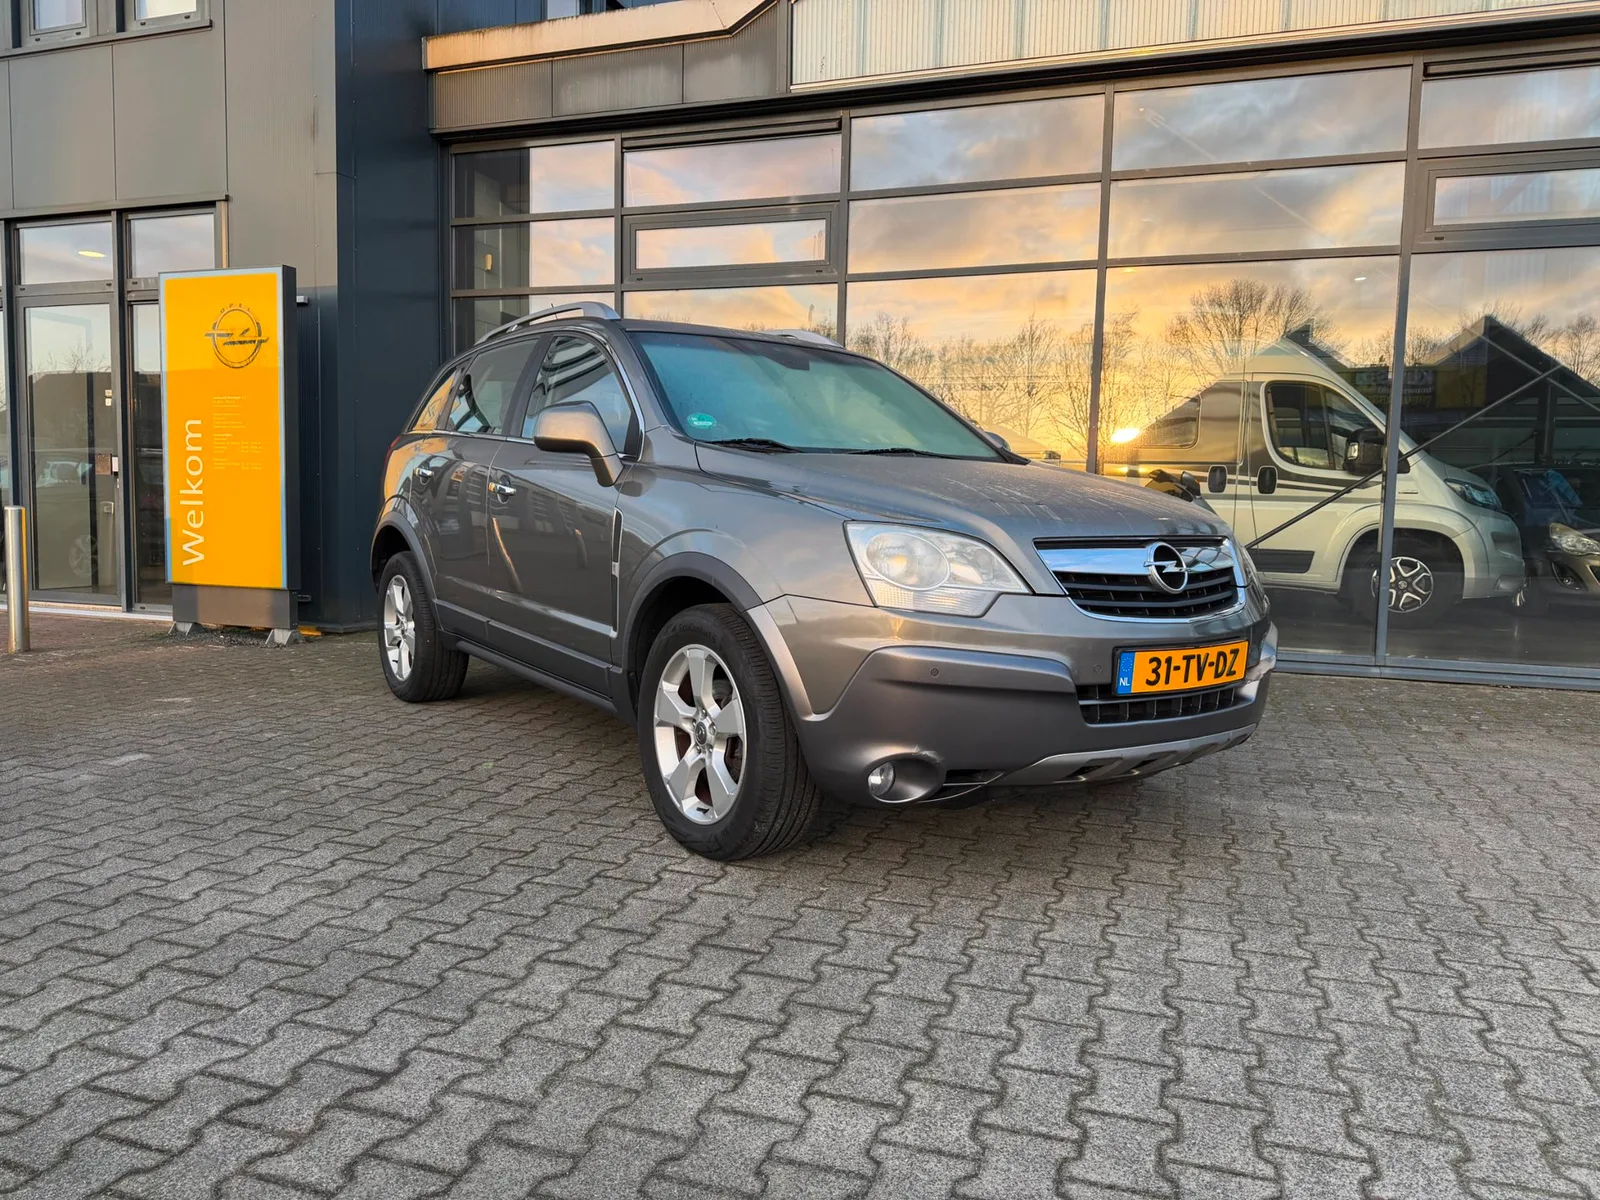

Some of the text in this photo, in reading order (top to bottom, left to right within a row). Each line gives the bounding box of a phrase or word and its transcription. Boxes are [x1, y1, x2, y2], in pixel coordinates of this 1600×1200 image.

[179, 419, 205, 566] Welkom
[1119, 677, 1130, 686] NL
[1145, 648, 1240, 686] 31-TV-DZ
